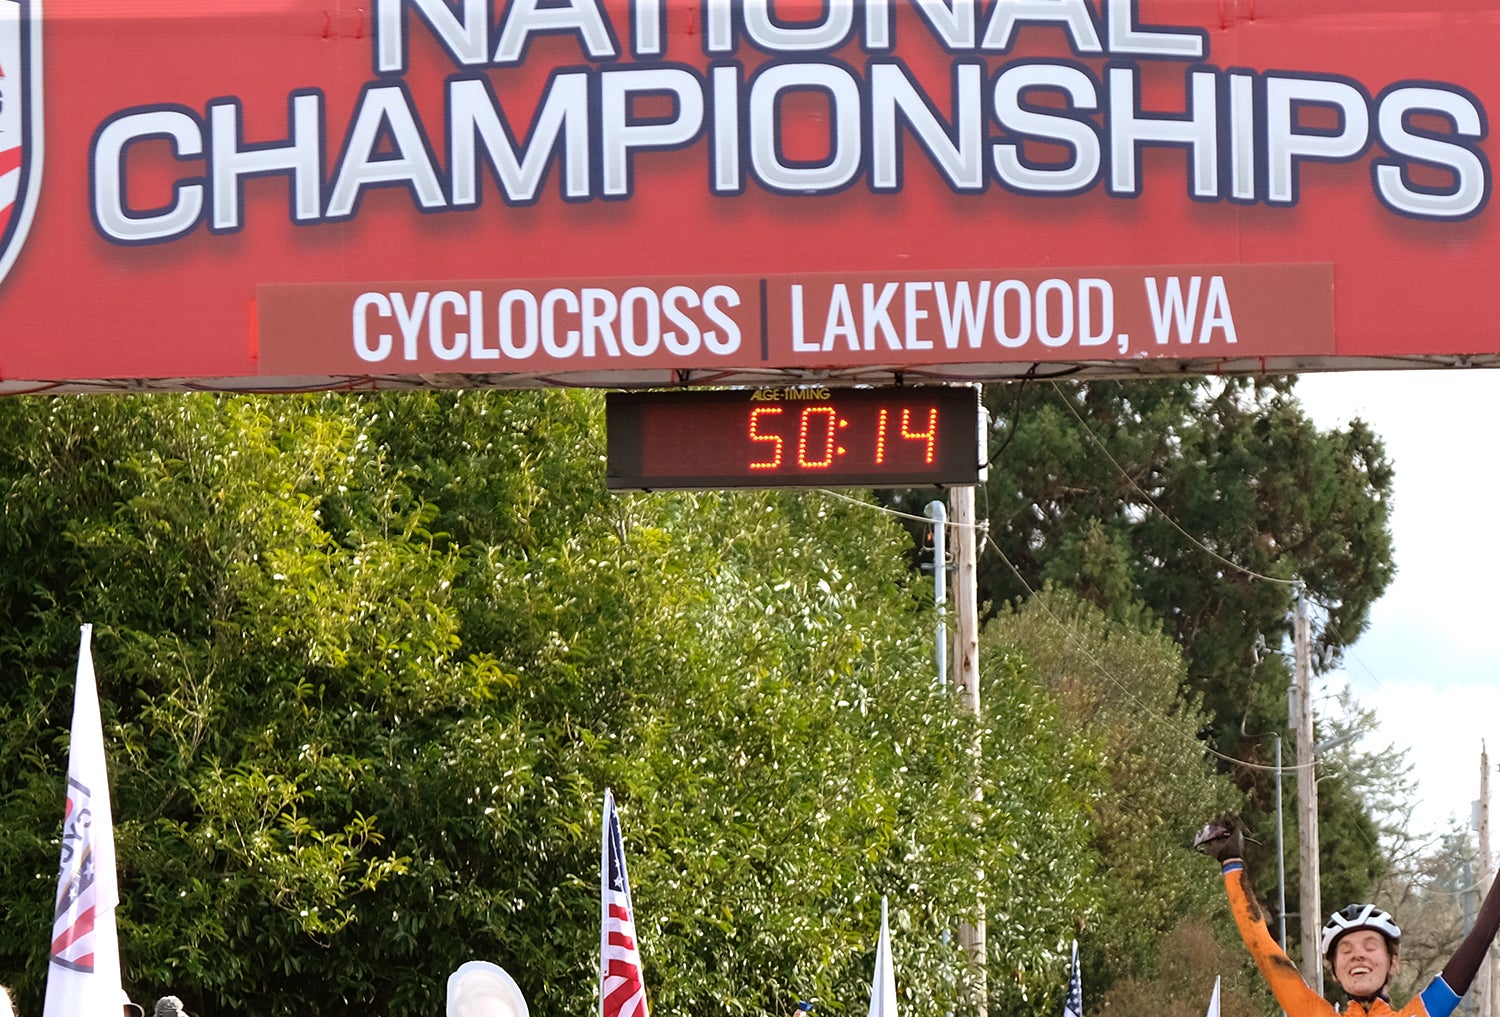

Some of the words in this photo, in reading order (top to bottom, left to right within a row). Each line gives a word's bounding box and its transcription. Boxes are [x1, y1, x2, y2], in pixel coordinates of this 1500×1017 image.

[92, 60, 1490, 243] CHAMPIONSHIPS
[352, 285, 742, 363] CYCLOCROSS
[790, 277, 1131, 355] LAKEWOOD,
[1144, 275, 1238, 345] WA
[750, 388, 832, 401] ALGE-TIMING
[749, 407, 938, 469] 50:14
